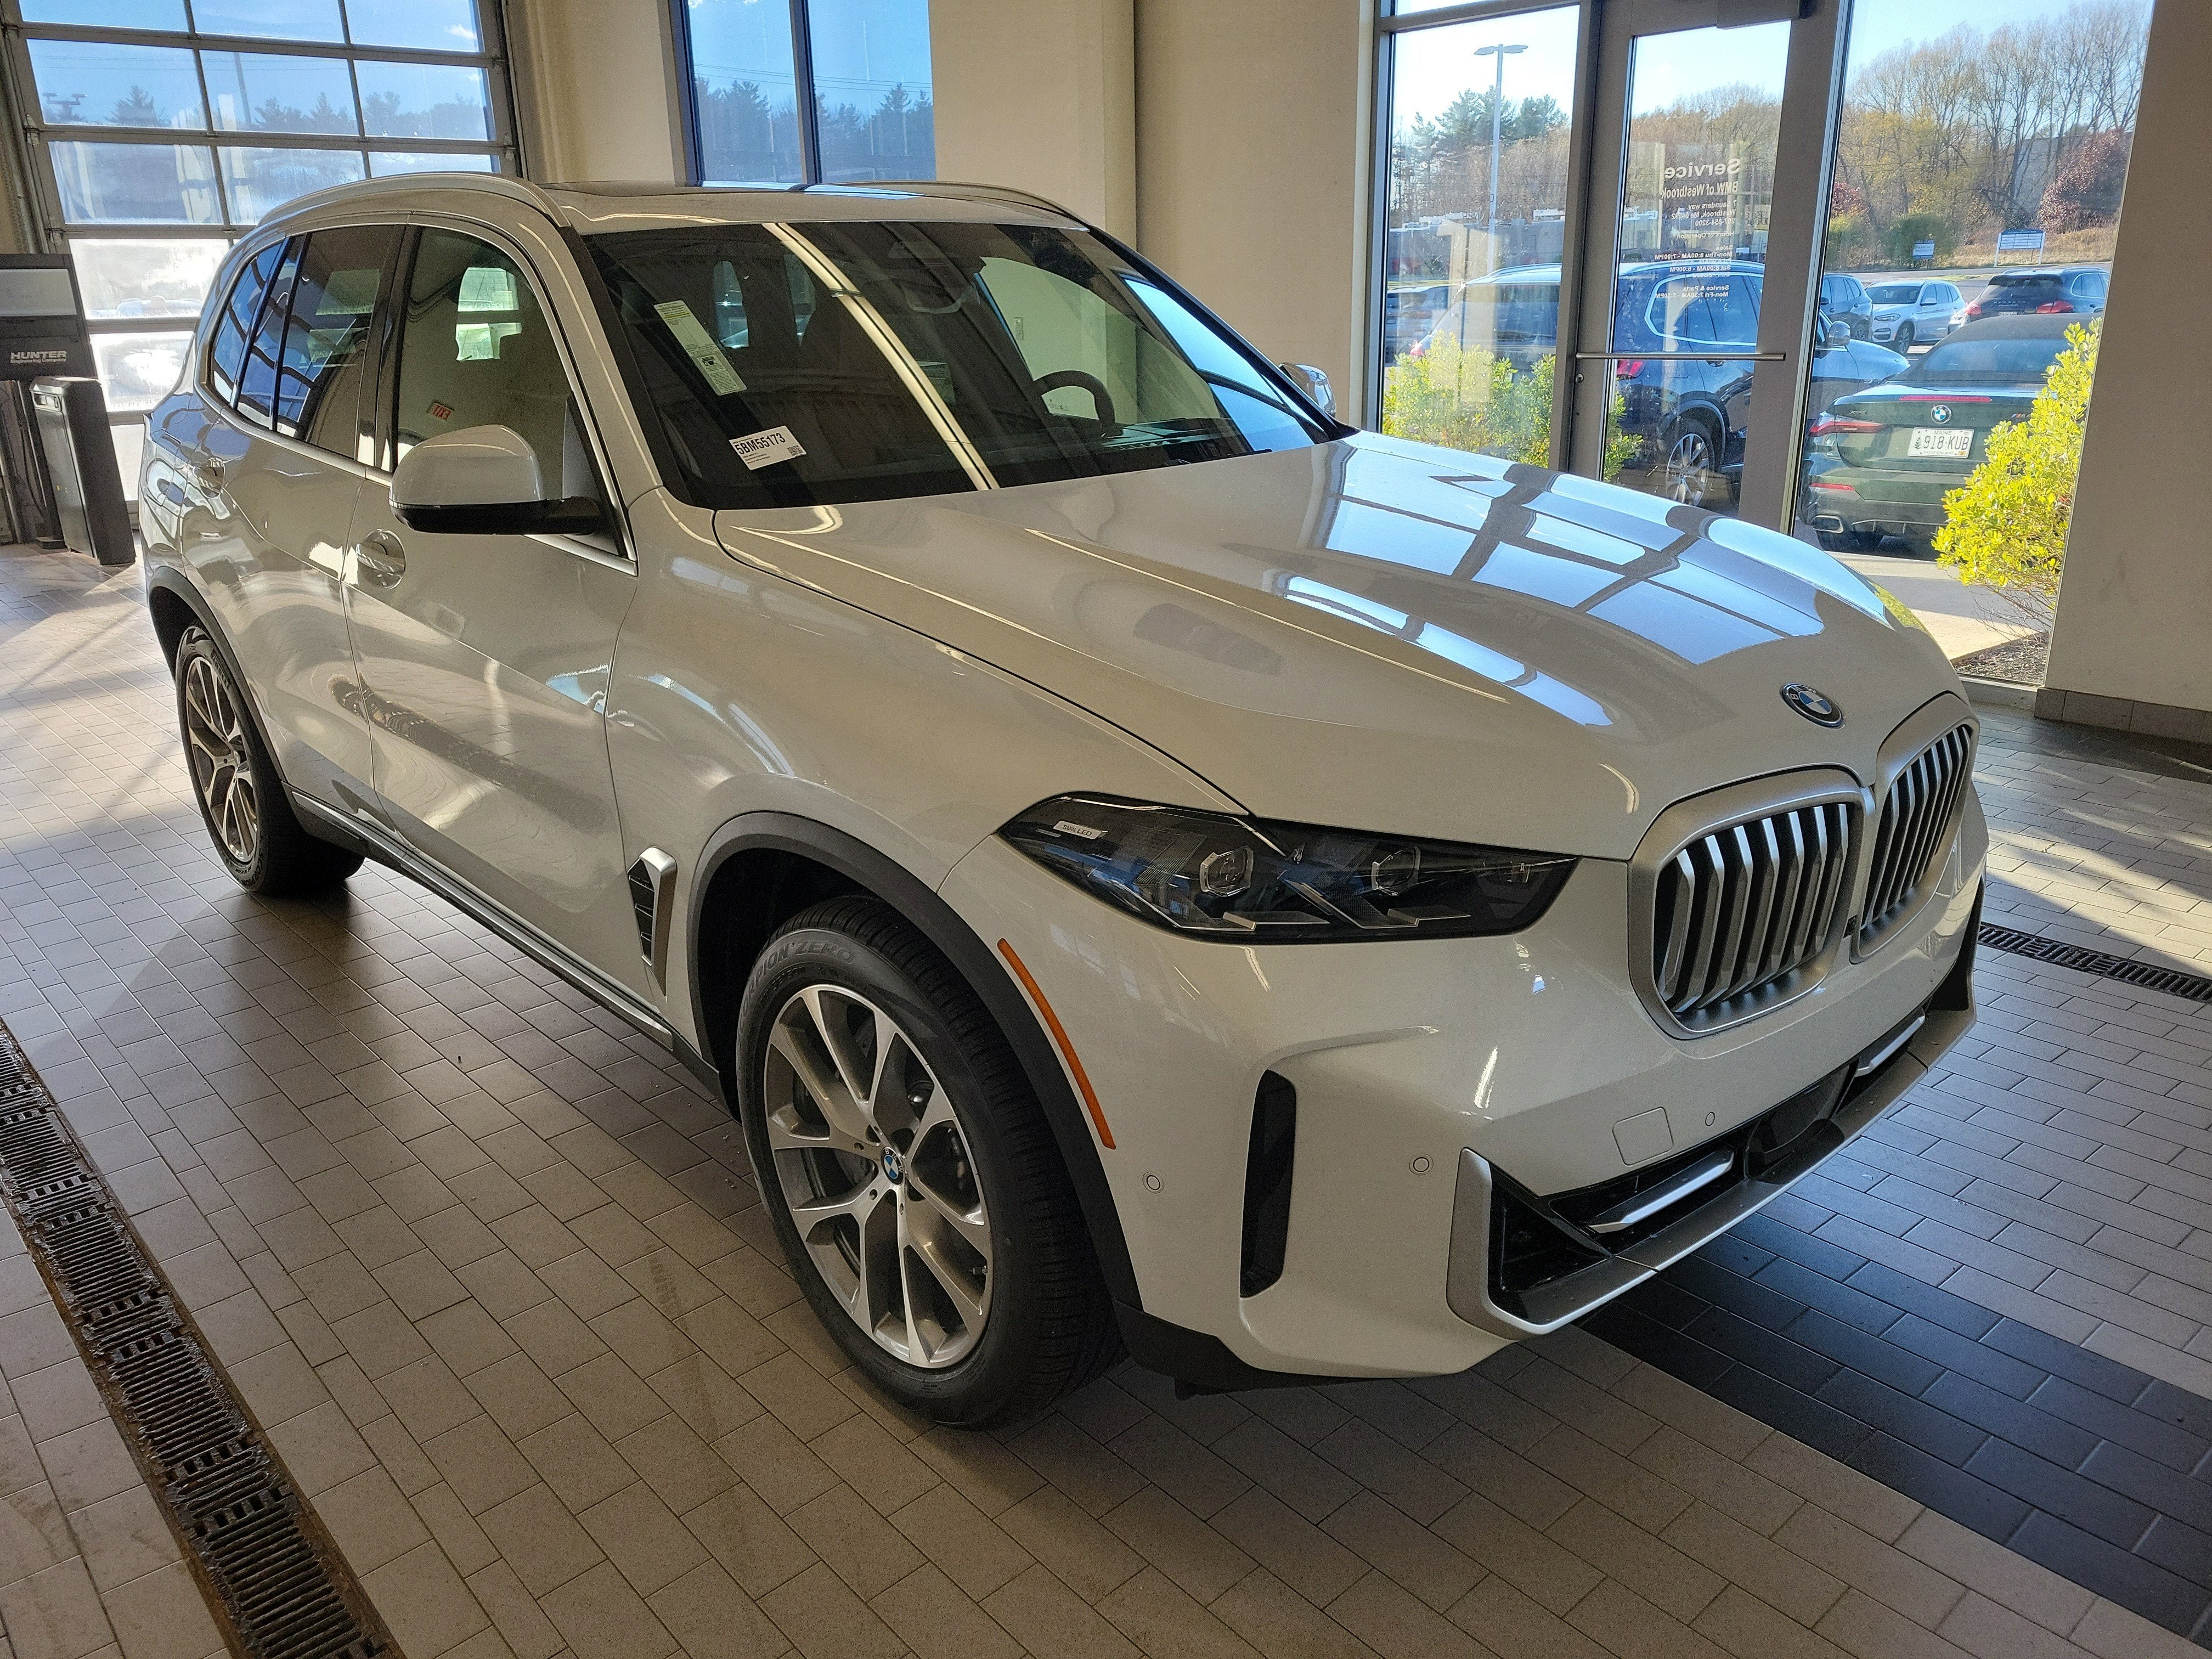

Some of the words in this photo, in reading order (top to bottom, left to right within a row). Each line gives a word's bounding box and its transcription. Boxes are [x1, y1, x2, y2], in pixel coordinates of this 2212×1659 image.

[10, 351, 66, 359] HUNTER
[734, 432, 786, 455] 5BM55173
[795, 940, 855, 965] ZERO
